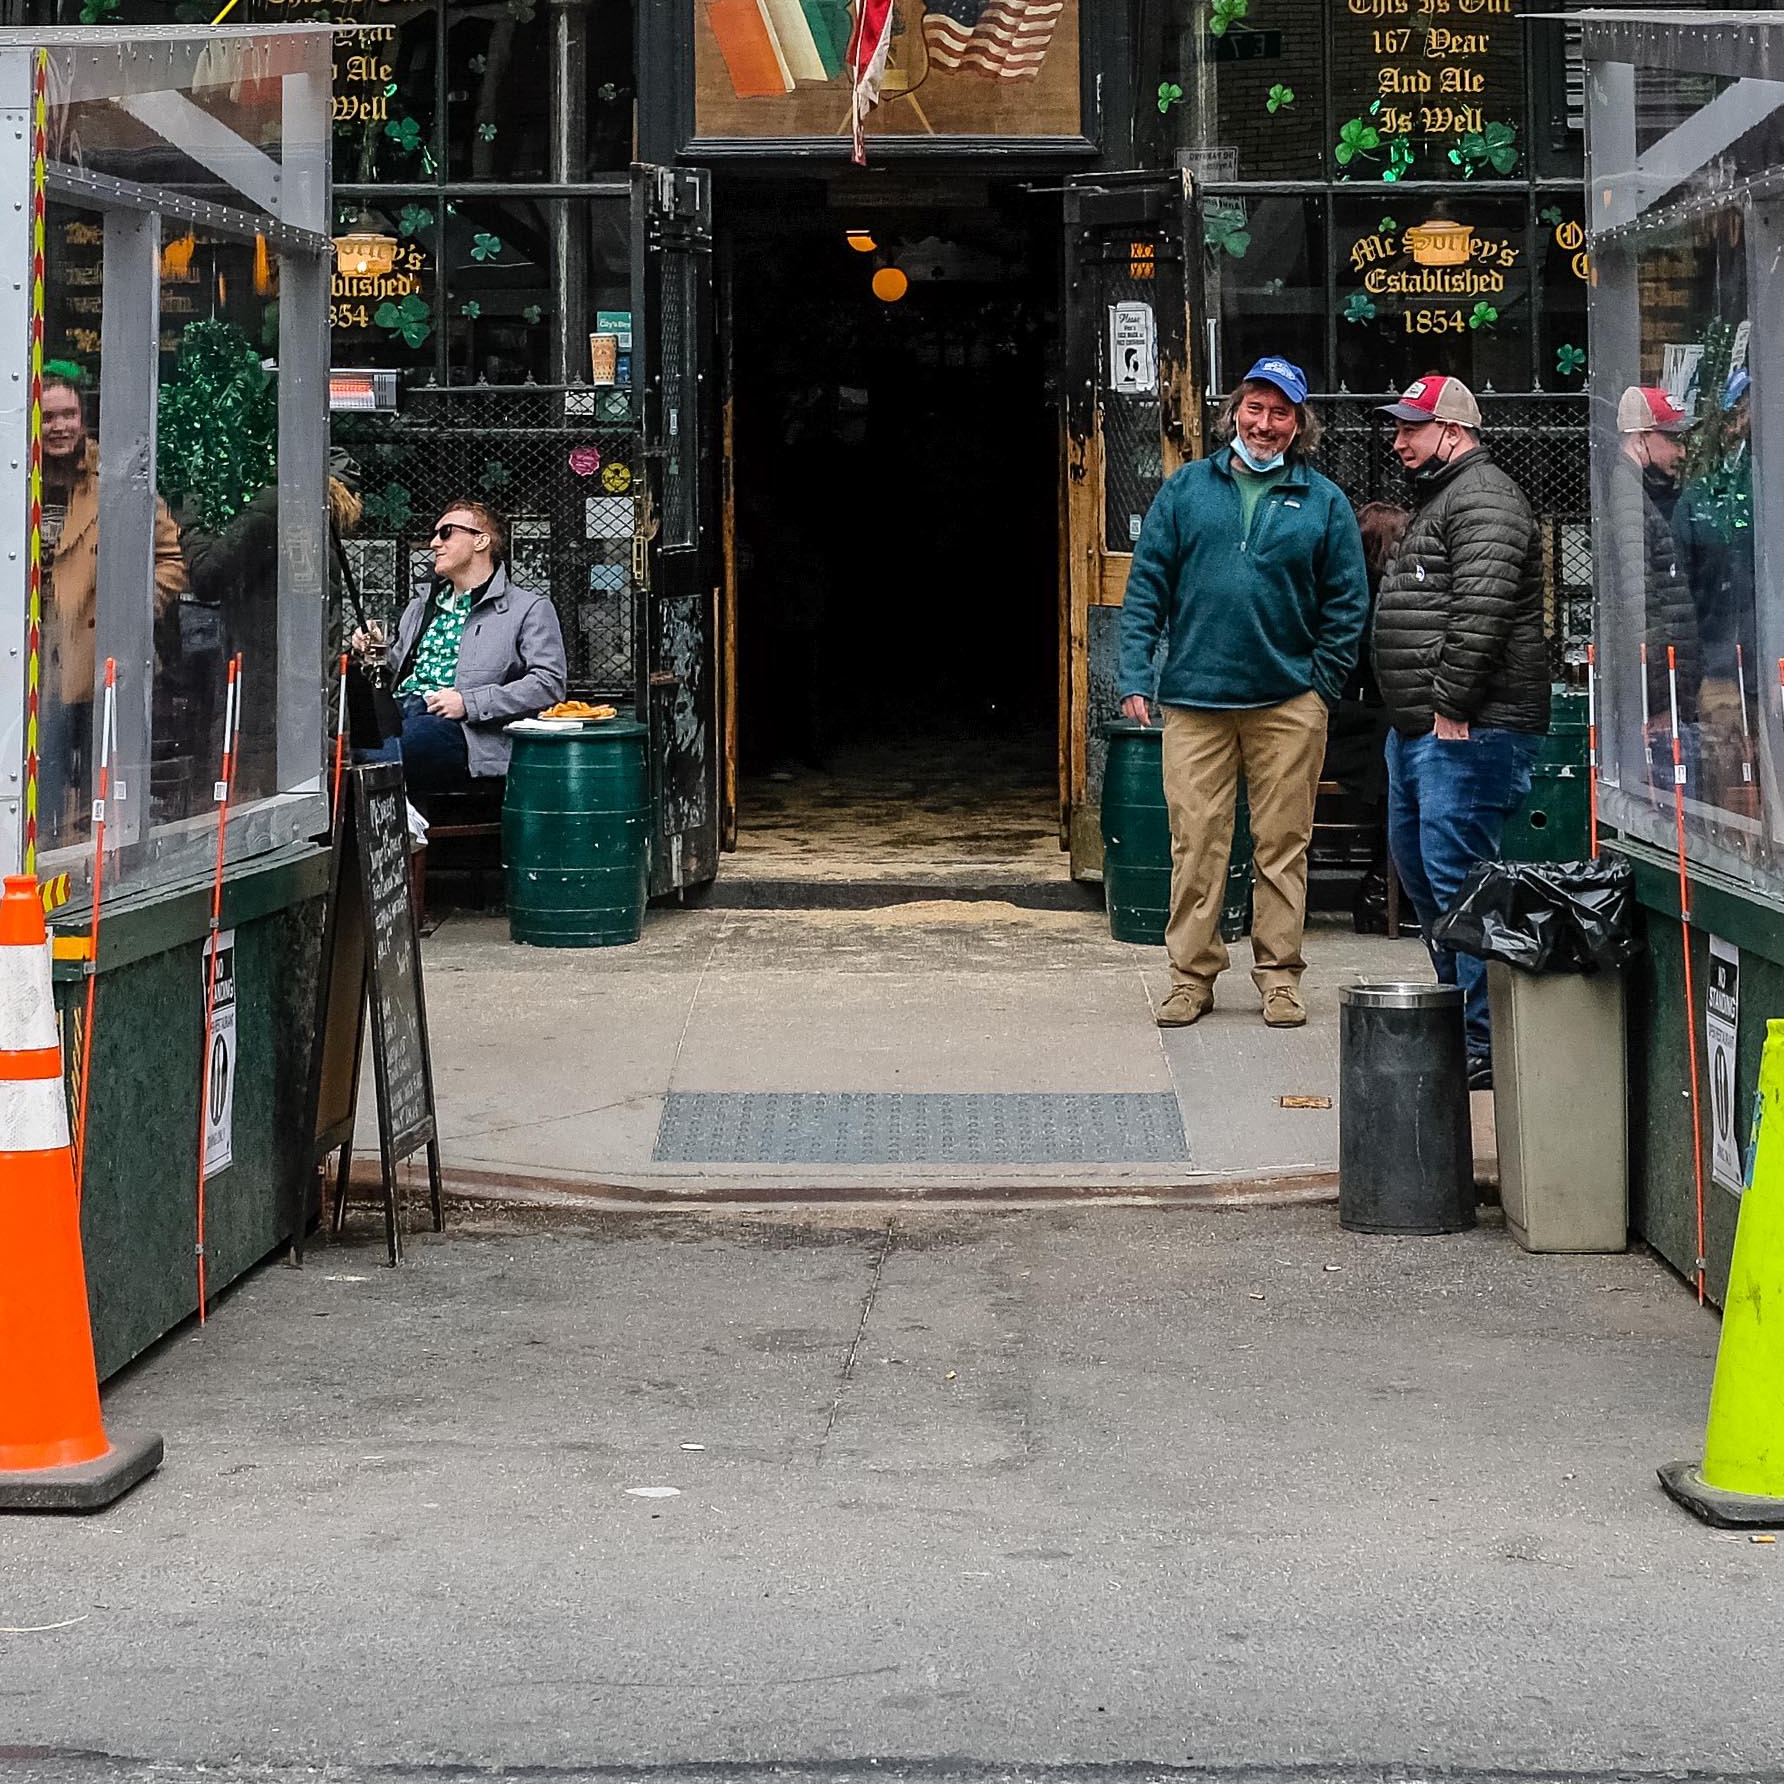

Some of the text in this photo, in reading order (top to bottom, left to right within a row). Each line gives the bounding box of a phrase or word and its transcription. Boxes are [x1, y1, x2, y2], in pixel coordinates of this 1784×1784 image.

[1372, 28, 1490, 59] 167 Year
[347, 56, 393, 82] Ale
[1378, 67, 1485, 95] And Ale
[1378, 106, 1483, 134] Is Well
[1364, 268, 1505, 297] Established
[1403, 308, 1466, 335] 1854
[1708, 986, 1736, 1018] STANDING
